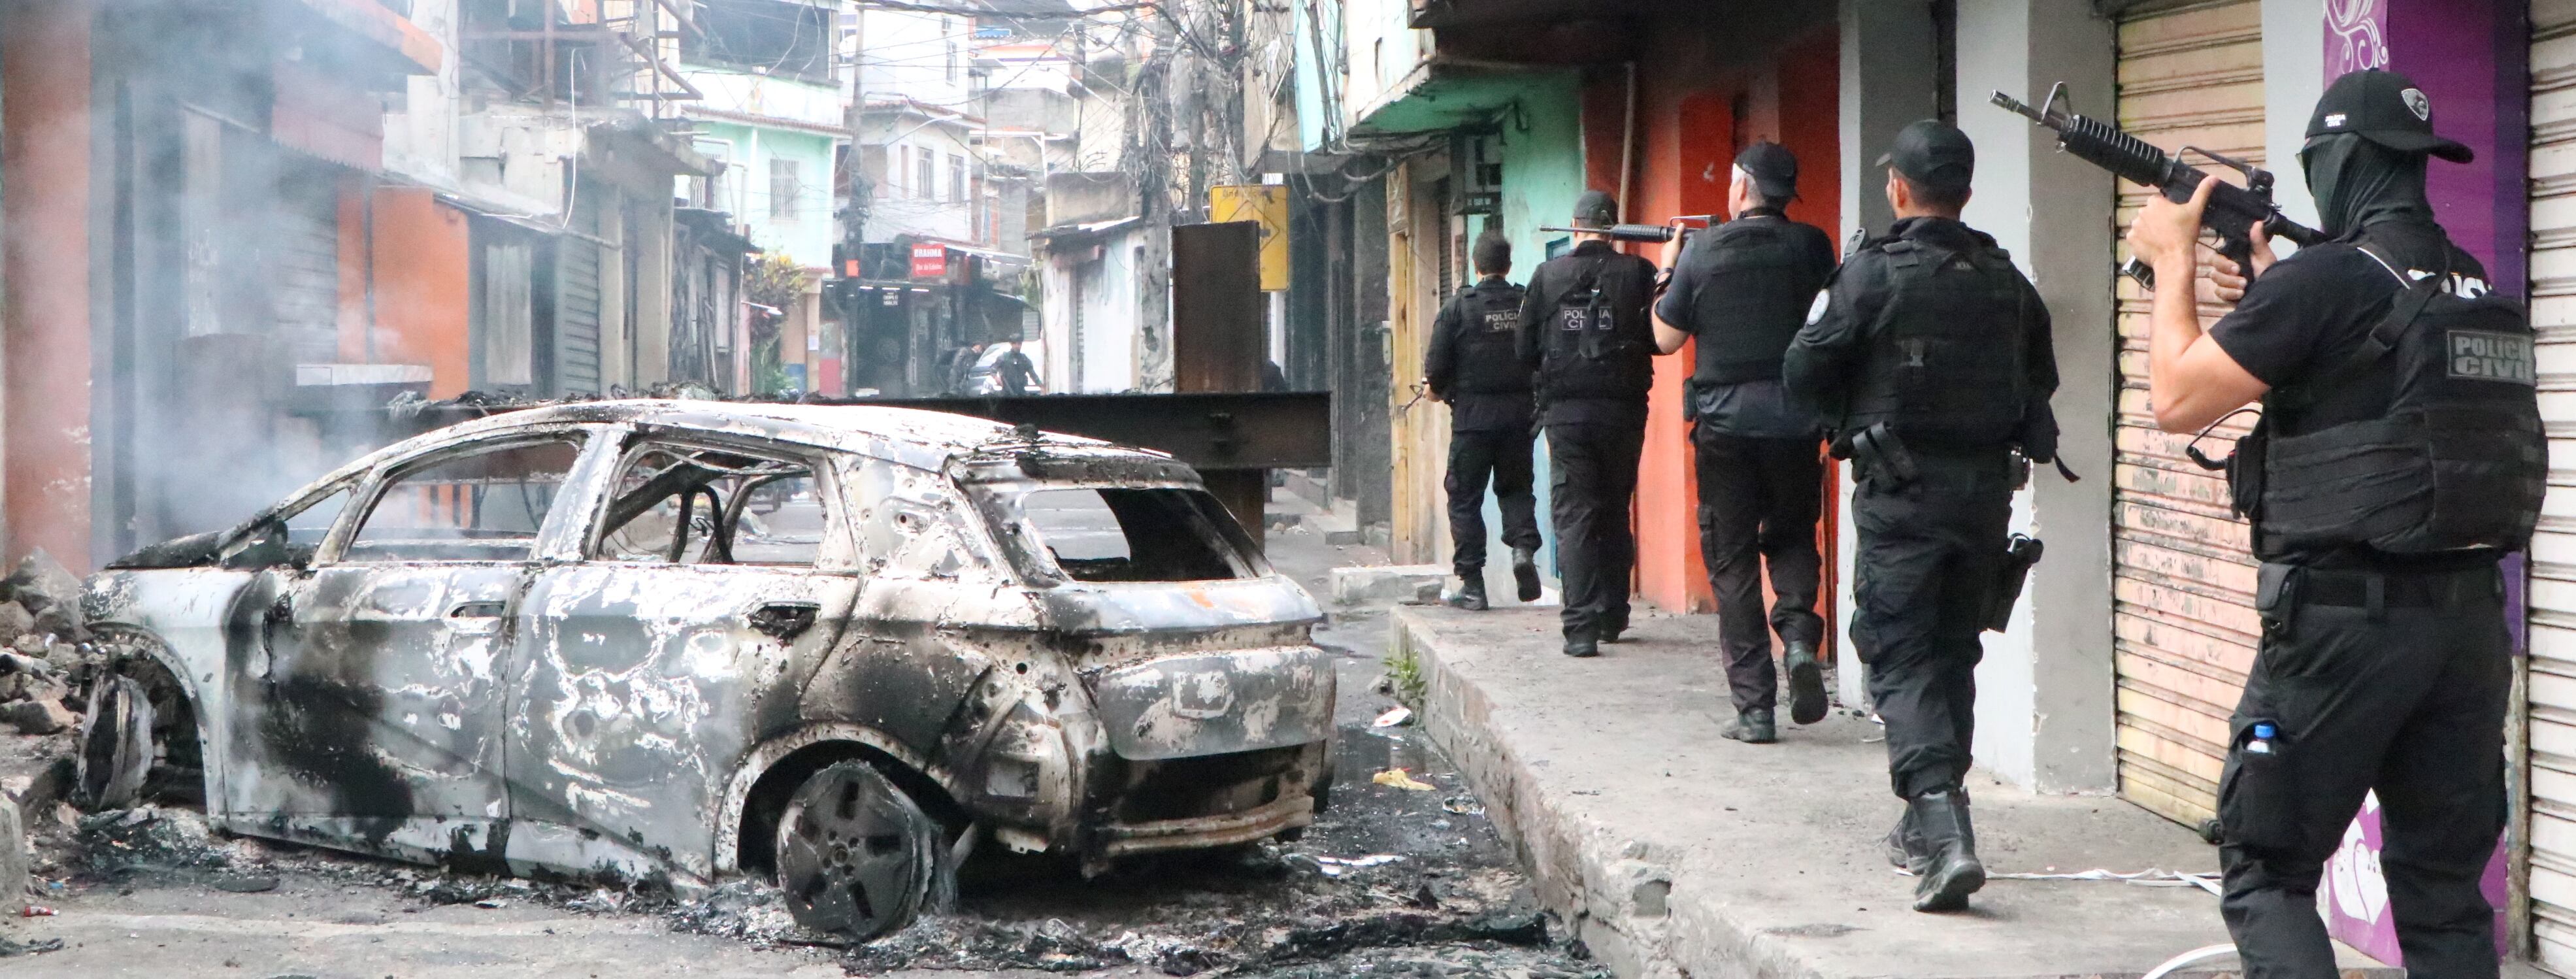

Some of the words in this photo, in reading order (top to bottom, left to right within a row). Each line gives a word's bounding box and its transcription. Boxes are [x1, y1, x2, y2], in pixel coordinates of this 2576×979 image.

[914, 248, 942, 257] BRAHMA
[1485, 310, 1517, 322] POLÍCI
[1564, 309, 1610, 320] POLIA
[1568, 319, 1607, 329] CIL
